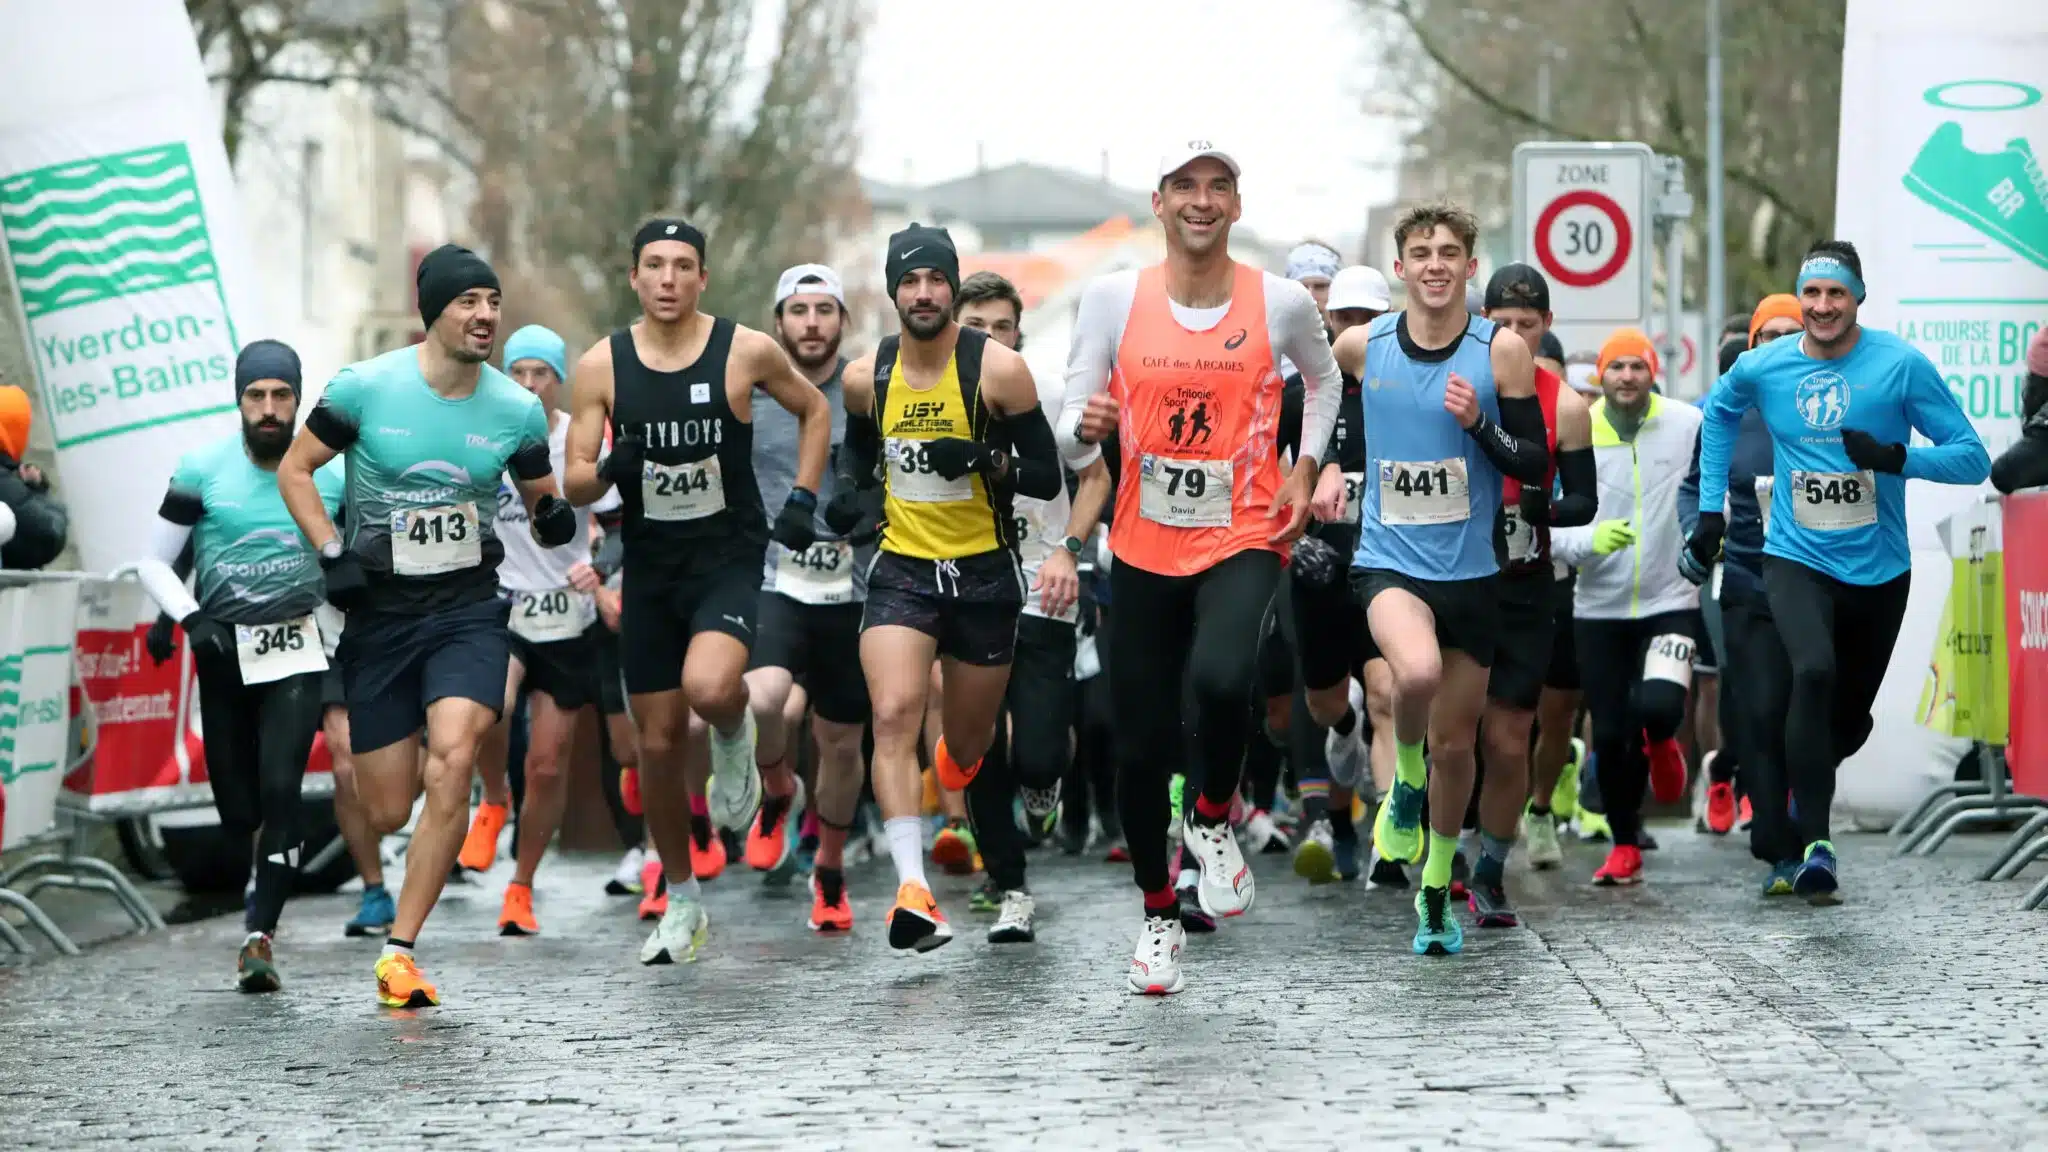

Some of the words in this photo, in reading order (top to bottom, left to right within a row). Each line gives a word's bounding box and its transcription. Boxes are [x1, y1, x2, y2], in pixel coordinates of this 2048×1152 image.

[1556, 163, 1610, 184] ZONE
[1986, 177, 2025, 219] BR
[1565, 221, 1602, 255] 30
[41, 313, 216, 369] Yverdon-
[1923, 320, 1992, 341] COURSE
[1173, 360, 1191, 369] des
[1194, 359, 1244, 372] ARCADES
[1942, 345, 1963, 365] DE
[1970, 344, 1991, 365] LA
[53, 354, 230, 416] les-Bains
[1177, 387, 1212, 399] Trilogie
[903, 402, 945, 418] USY
[1164, 397, 1188, 408] Sport
[655, 468, 709, 497] 244
[1164, 467, 1206, 498] 79
[1394, 468, 1448, 497] 441
[1805, 479, 1861, 505] 548
[1171, 506, 1195, 515] David
[409, 513, 466, 545] 413
[792, 547, 840, 571] 443
[523, 592, 569, 618] 240
[254, 624, 305, 655] 345
